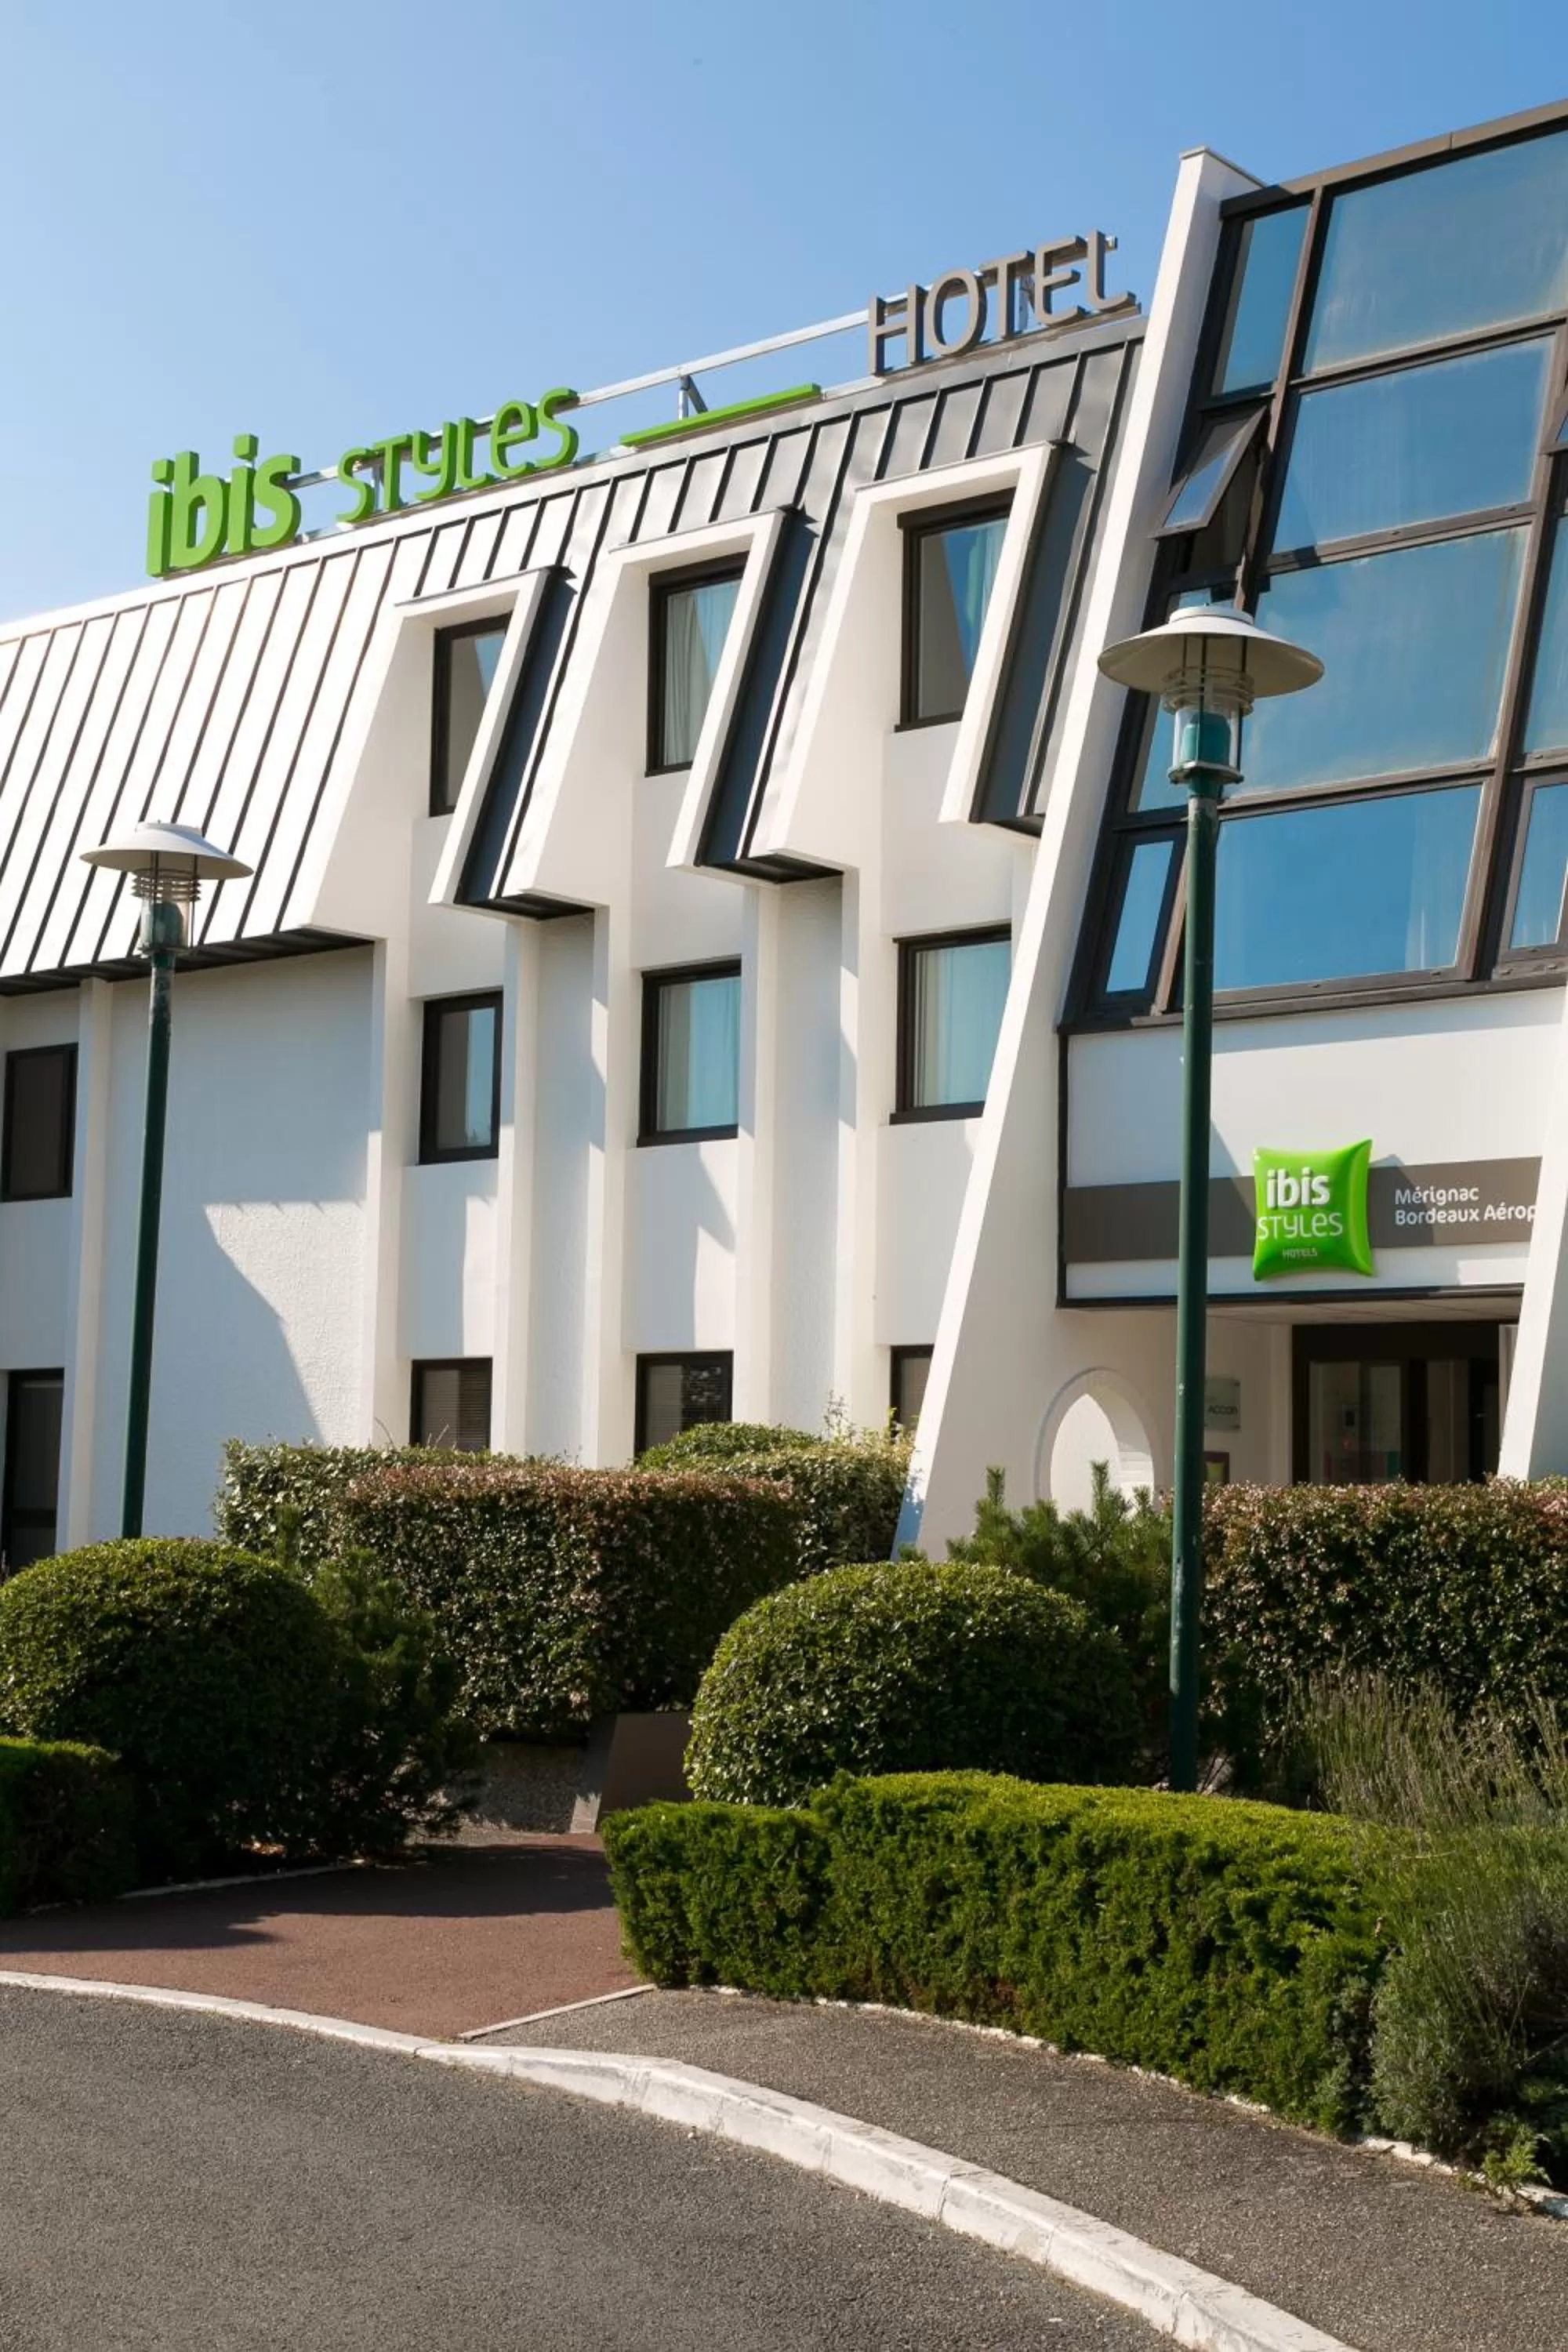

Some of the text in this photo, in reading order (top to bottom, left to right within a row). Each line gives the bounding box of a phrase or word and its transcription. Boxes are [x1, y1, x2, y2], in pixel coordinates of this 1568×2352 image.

[868, 230, 1137, 376] HOTEL
[147, 434, 302, 577] ibis
[1266, 1167, 1331, 1208] ibis
[1395, 1185, 1479, 1206] Mérignac
[1395, 1207, 1481, 1225] Bordeaux
